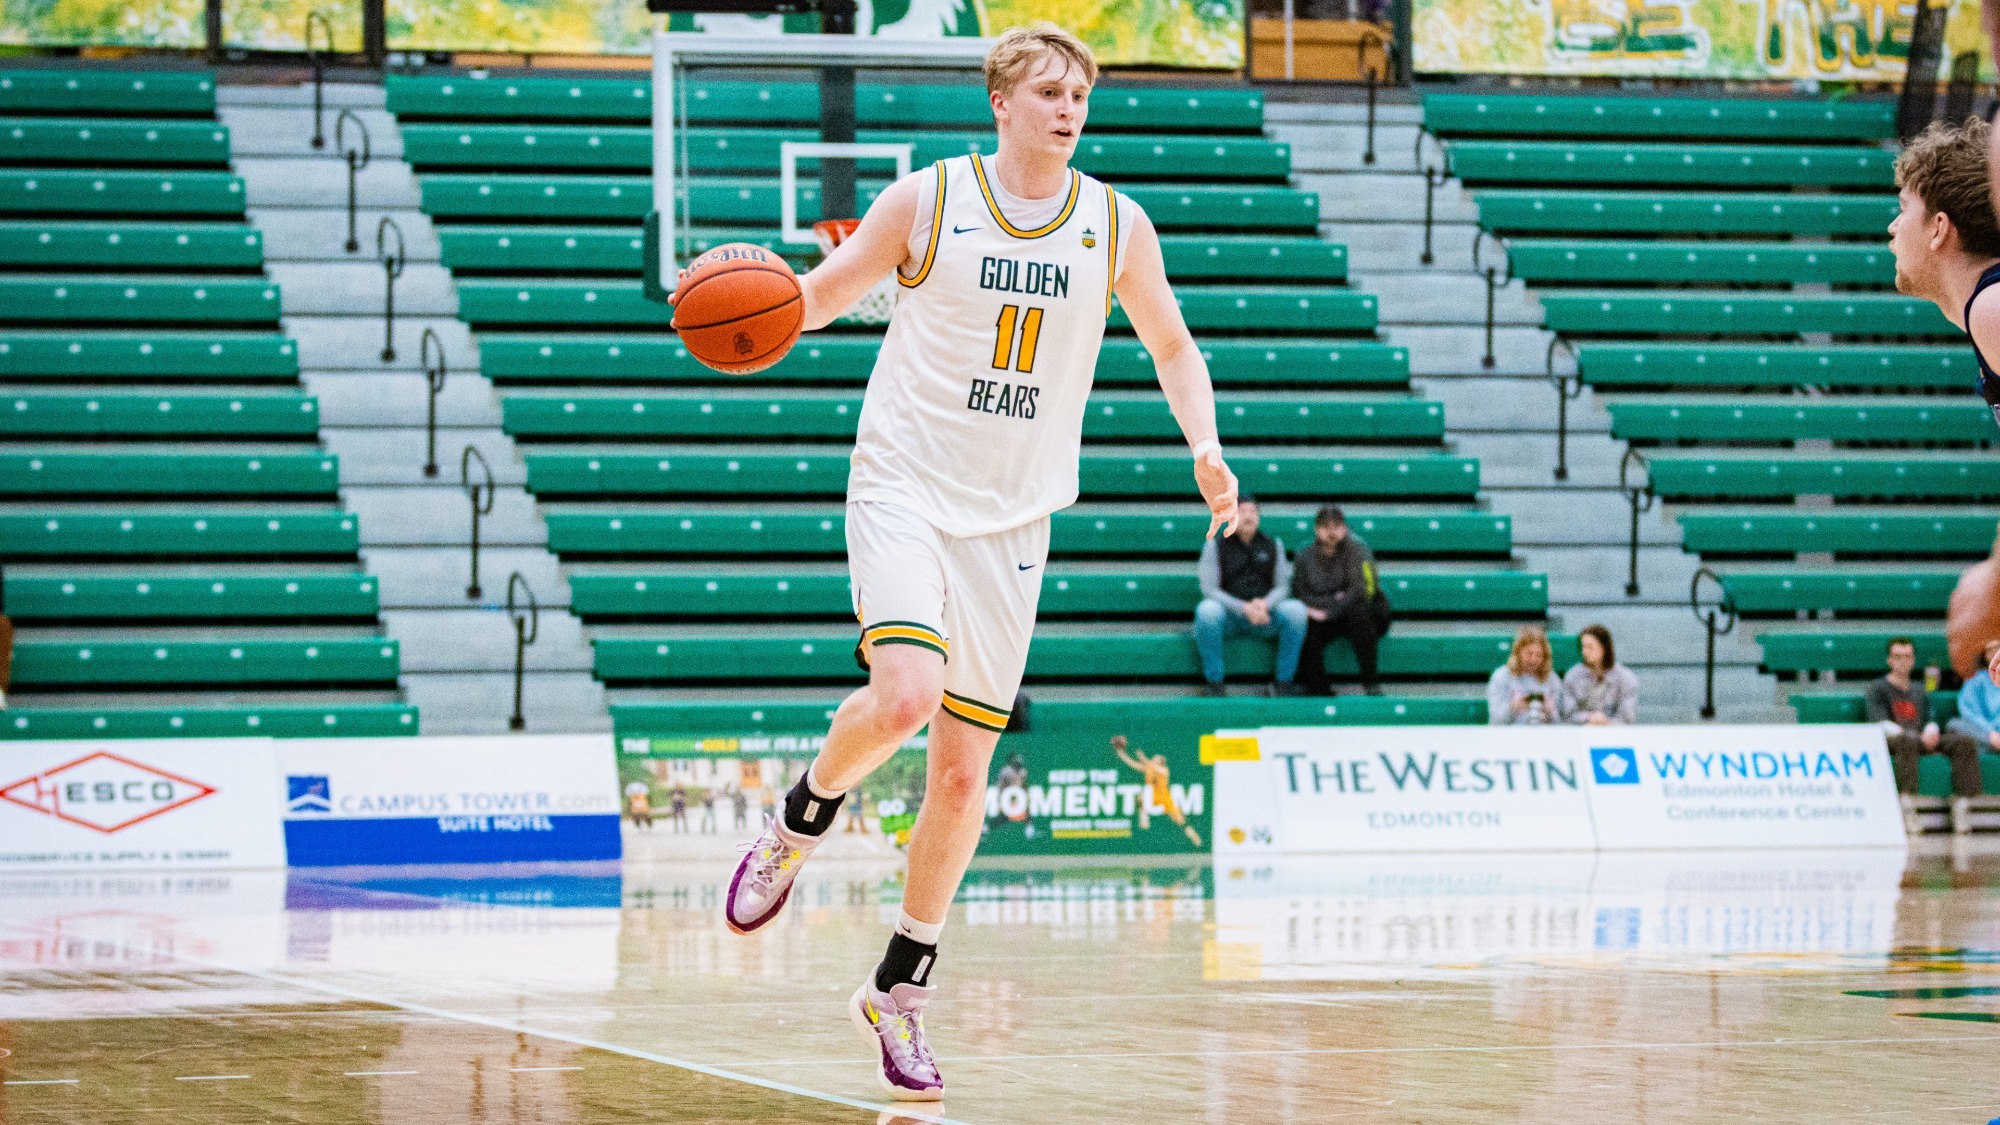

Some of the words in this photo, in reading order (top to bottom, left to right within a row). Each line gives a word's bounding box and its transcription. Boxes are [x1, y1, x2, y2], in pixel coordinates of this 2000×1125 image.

[980, 256, 1069, 299] GOLDEN
[991, 303, 1044, 374] 11
[967, 378, 1040, 420] BEARS
[1089, 768, 1118, 784] THE
[1273, 752, 1376, 794] THE
[1377, 751, 1578, 793] WESTIN
[1649, 751, 1874, 779] WYNDHAM
[34, 776, 175, 815] HESCO
[1662, 783, 1773, 798] Edmonton
[1778, 780, 1834, 797] Hotel
[339, 793, 450, 813] CAMPUS
[1666, 804, 1789, 821] Conference
[1795, 802, 1866, 819] Centre
[437, 815, 491, 833] SUITE
[494, 814, 554, 832] HOTEL
[1367, 811, 1501, 829] EDMONTON
